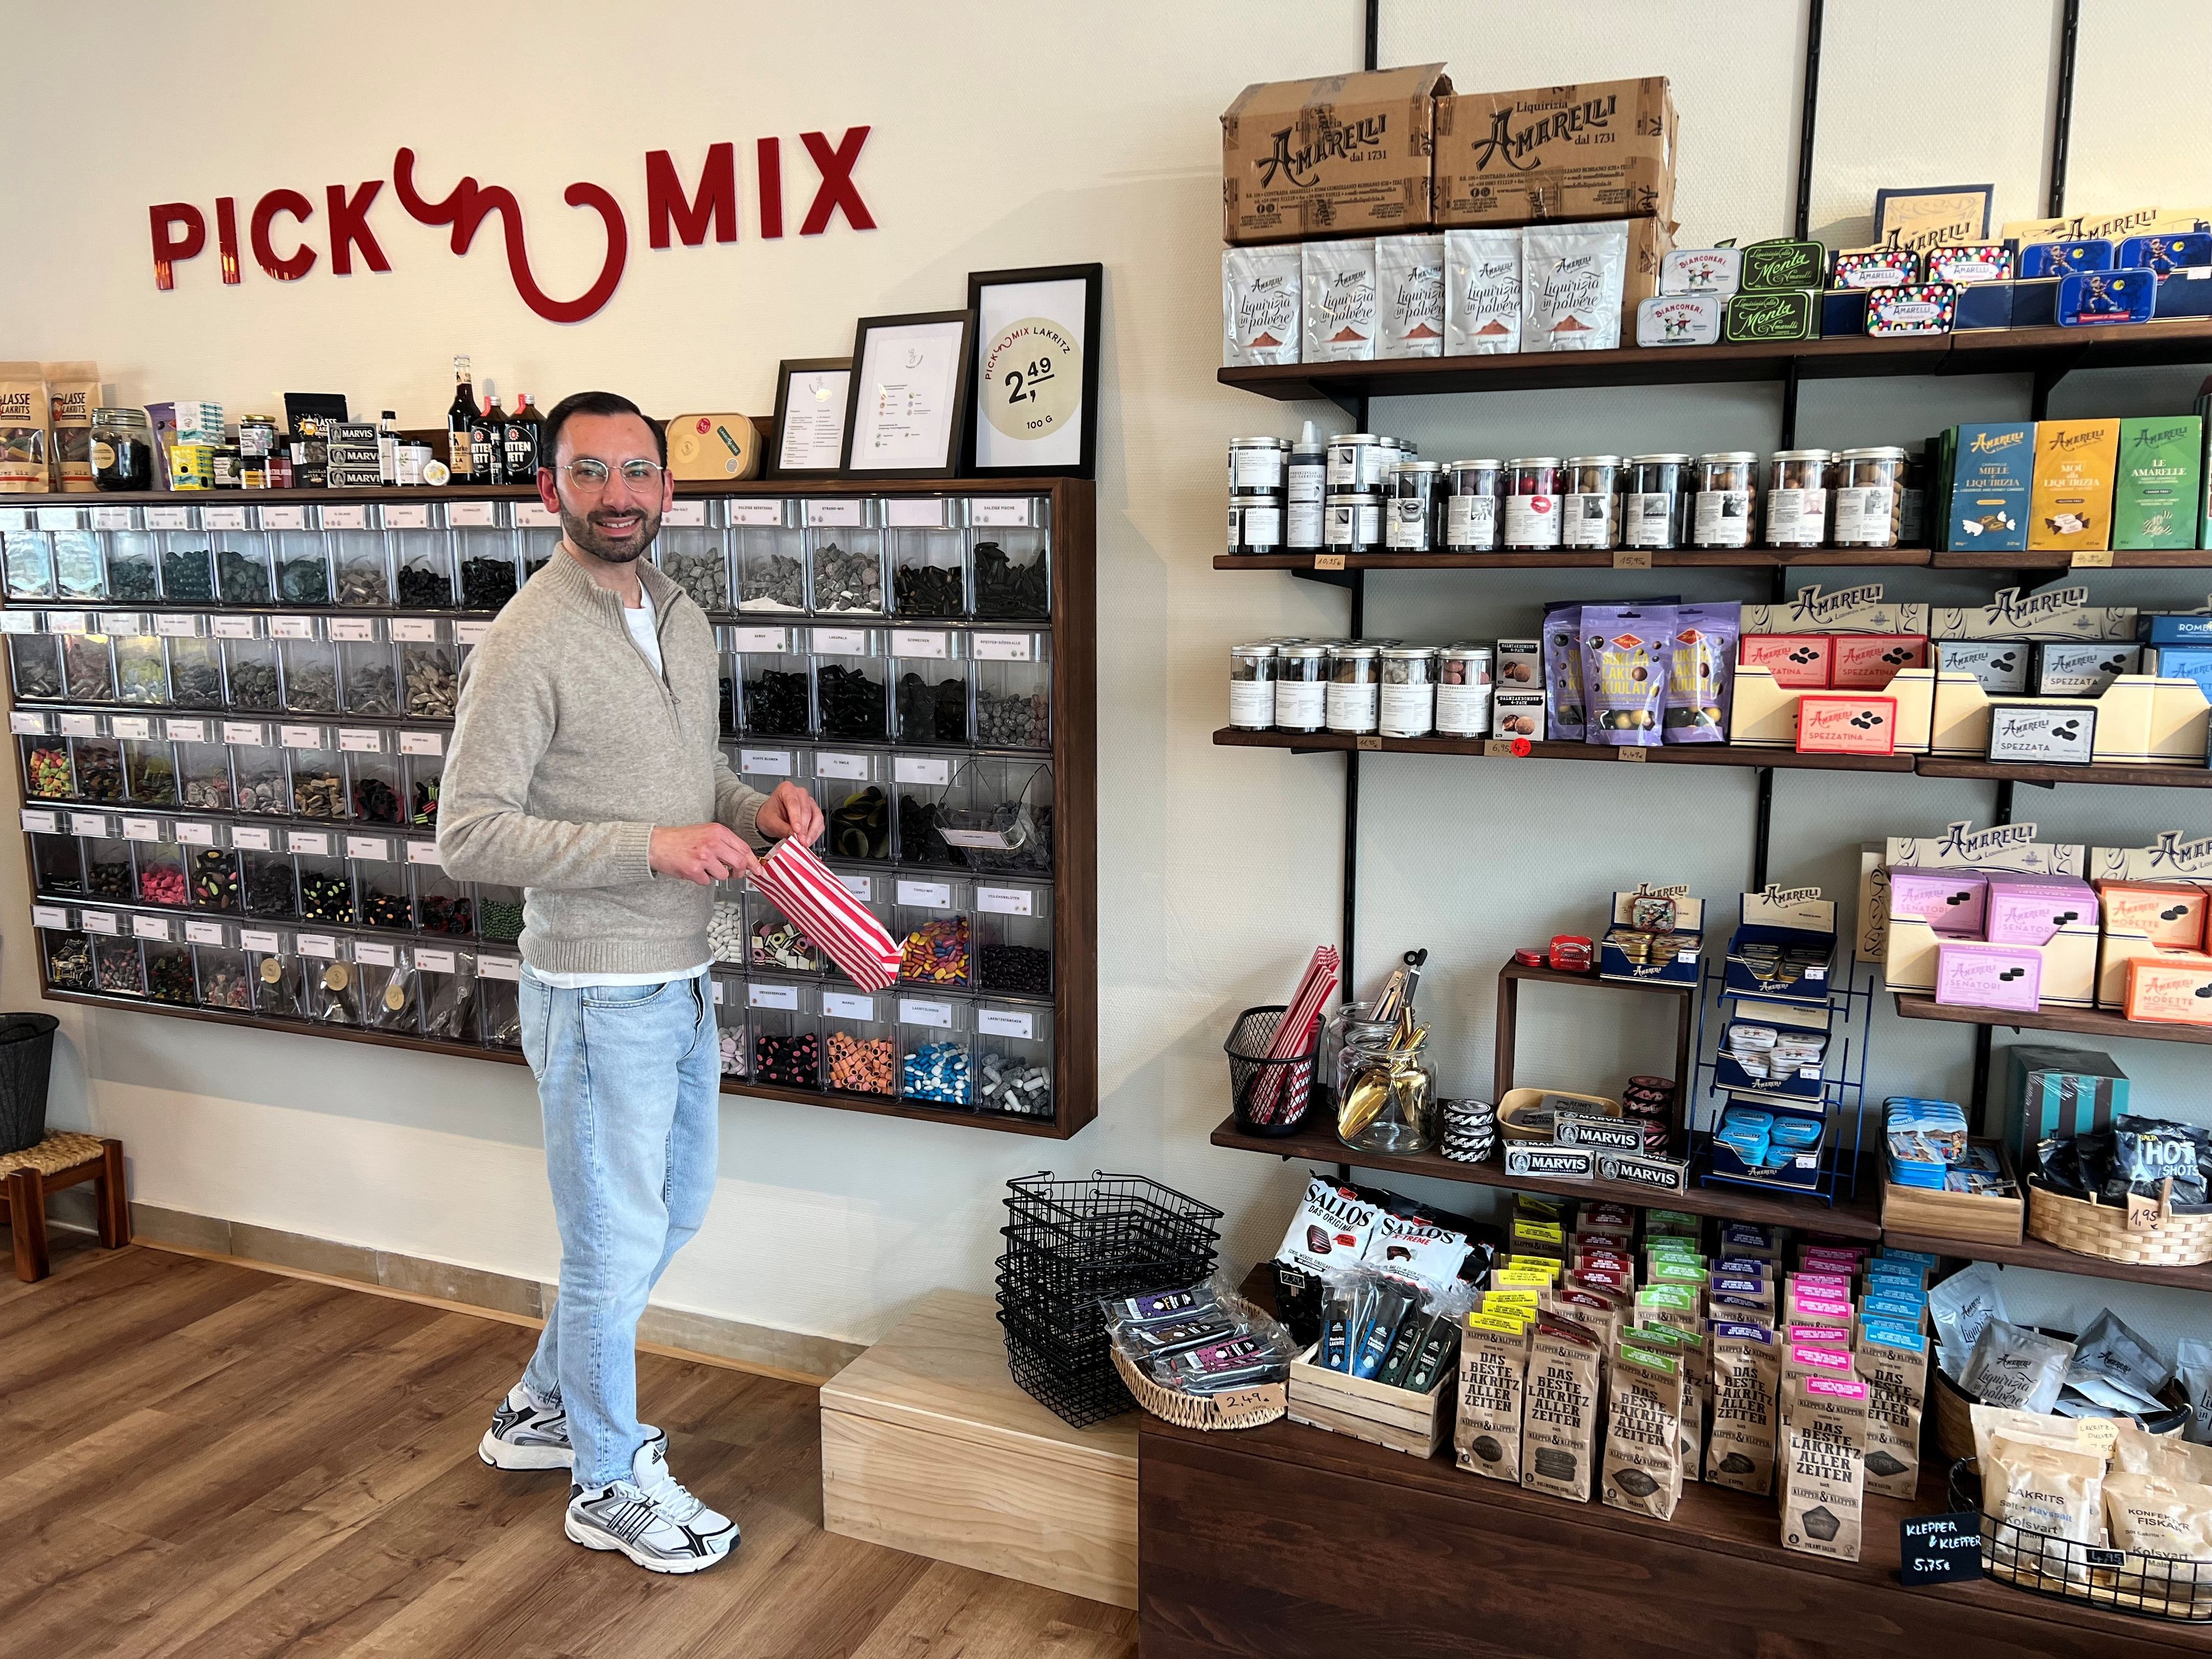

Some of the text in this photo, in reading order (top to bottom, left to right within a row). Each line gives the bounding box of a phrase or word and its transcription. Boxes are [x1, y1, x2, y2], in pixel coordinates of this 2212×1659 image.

[1516, 101, 1568, 114] Liquirizia
[1472, 95, 1616, 171] AMARELLI
[1575, 133, 1615, 145] dal 1731
[1256, 114, 1386, 188] AMARELLI
[1350, 150, 1386, 162] dal 1731
[149, 180, 392, 290] PICK
[645, 126, 877, 249] MIX
[2056, 209, 2157, 242] AMARELLI
[1749, 250, 1810, 285] Menta
[1467, 278, 1521, 301] Liquirizia
[1543, 272, 1604, 299] Liquirizia
[1240, 291, 1295, 316] Liquirizia
[1324, 285, 1375, 312] Liquirizia
[1552, 294, 1602, 318] polvere
[1330, 305, 1375, 329] polvere
[1476, 297, 1521, 321] polvere
[1734, 300, 1796, 335] Menta
[1249, 311, 1293, 334] polvere
[985, 353, 997, 380] PICK
[1011, 327, 1030, 340] MIX
[1034, 327, 1071, 354] LAKRITZ
[2, 393, 30, 405] LASSE
[63, 392, 86, 404] LASSE
[2, 405, 30, 415] LAKRITS
[62, 405, 86, 414] LAKRITS
[1026, 419, 1043, 429] 100
[342, 429, 373, 438] MARVIS
[2131, 468, 2187, 476] AMARELLE
[1966, 479, 2020, 487] LIQUIRIZIA
[1790, 586, 1881, 624] AMARELLI
[1985, 587, 2085, 627] AMARELLI
[1603, 652, 1650, 667] SUKLAA
[1603, 681, 1648, 695] KUULAT
[1810, 711, 1853, 728] AMARELLI
[2002, 719, 2049, 738] AMARELLI
[1809, 733, 1863, 741] SPEZZATINA
[2001, 743, 2050, 752] SPEZZATA
[1938, 823, 2034, 861] AMARELLI
[1761, 884, 1818, 908] AMARELLI
[1900, 904, 1949, 914] SENATORI
[2003, 924, 2054, 934] SENATORI
[2111, 919, 2159, 928] MORETTE
[1950, 980, 2001, 990] SENATORI
[2143, 996, 2194, 1006] MORETTE
[1889, 1115, 1916, 1126] Amarelli
[1580, 1129, 1636, 1145] MARVIS
[2145, 1141, 2196, 1166] HOT
[1532, 1157, 1587, 1170] MARVIS
[2162, 1164, 2200, 1178] SHOTS
[1620, 1166, 1677, 1185] MARVIS
[1303, 1183, 1375, 1227] SALLOS
[1308, 1204, 1354, 1232] DAS ORIGINAL
[1381, 1217, 1456, 1244] SALLOS
[1392, 1233, 1432, 1246] X-TREME
[1467, 1331, 1489, 1340] KLEPPER
[1490, 1333, 1498, 1343] &
[1479, 1352, 1506, 1365] DAS
[1536, 1344, 1558, 1354] KLEPPER
[1558, 1346, 1566, 1357] &
[1470, 1361, 1512, 1378] BESTE
[1547, 1366, 1573, 1381] DAS
[1618, 1363, 1650, 1379] KLEPPER &
[1733, 1366, 1758, 1379] DAS
[1875, 1369, 1903, 1384] DAS
[1977, 1363, 2038, 1392] Liquirizia
[1460, 1371, 1520, 1391] LAKRITZ
[1537, 1376, 1581, 1395] BESTE
[1724, 1375, 1766, 1392] BESTE
[1467, 1384, 1511, 1401] ALLER
[1528, 1385, 1589, 1407] LAKRITZ
[1631, 1384, 1658, 1400] DAS
[1714, 1384, 1773, 1407] LAKRITZ
[1465, 1395, 1512, 1412] ZEITEN
[1535, 1398, 1580, 1417] ALLER
[1620, 1392, 1666, 1413] BESTE
[1721, 1397, 1766, 1415] ALLER
[1799, 1399, 1835, 1413] KLEPPER &
[1532, 1408, 1581, 1428] ZEITEN
[1610, 1402, 1676, 1427] LAKRITZ
[1717, 1407, 1767, 1426] ZEITEN
[1617, 1415, 1664, 1436] ALLER
[1813, 1420, 1843, 1435] DAS
[1615, 1426, 1665, 1447] ZEITEN
[1802, 1427, 1852, 1446] BESTE
[1792, 1437, 1861, 1460] LAKRITZ
[1799, 1451, 1851, 1470] ALLER
[1797, 1462, 1853, 1483] ZEITEN
[2007, 1486, 2065, 1506] LAKRITS
[2000, 1499, 2018, 1510] Salt
[2029, 1505, 2073, 1522] Havssalt
[1906, 1521, 1958, 1536] KLEPPER
[2004, 1514, 2058, 1534] Kolsvart
[2137, 1517, 2183, 1533] FISKAR
[1929, 1536, 1982, 1549] & KLEPPER
[2132, 1546, 2189, 1561] Kolsvart
